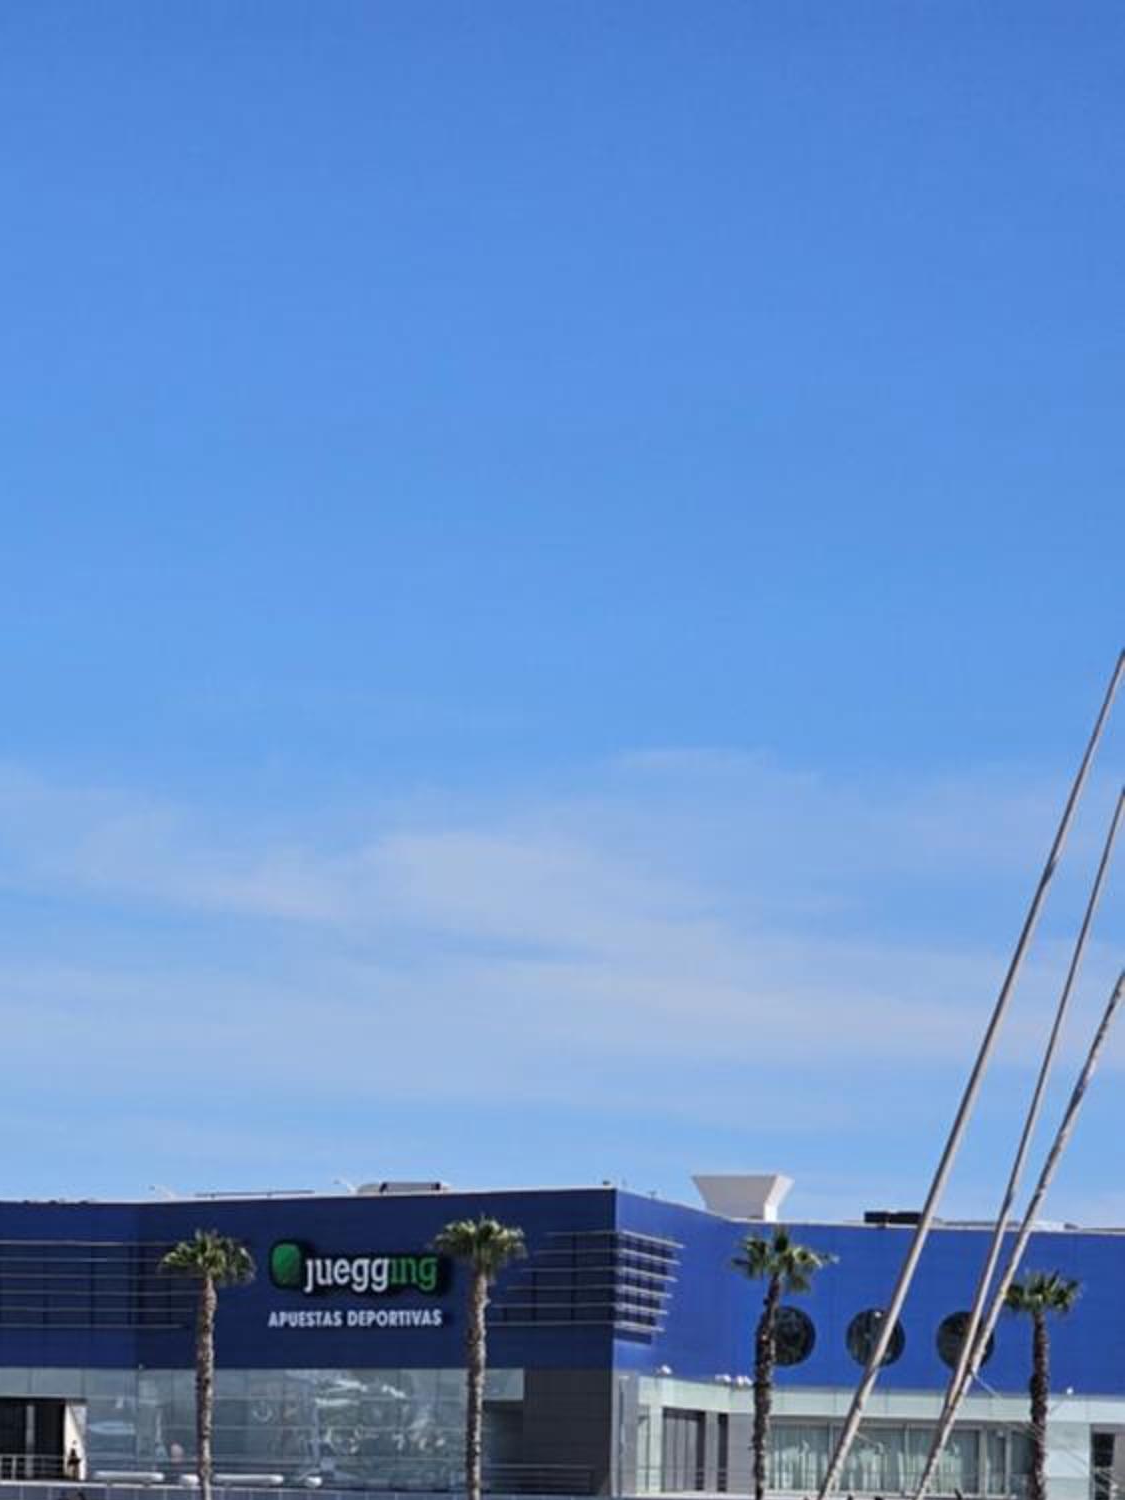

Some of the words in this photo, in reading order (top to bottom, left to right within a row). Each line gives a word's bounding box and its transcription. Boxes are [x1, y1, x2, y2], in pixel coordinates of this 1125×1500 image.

[304, 1257, 438, 1293] juegging
[268, 1311, 342, 1328] APUESTAS
[347, 1309, 442, 1327] DEPORTIVAS
